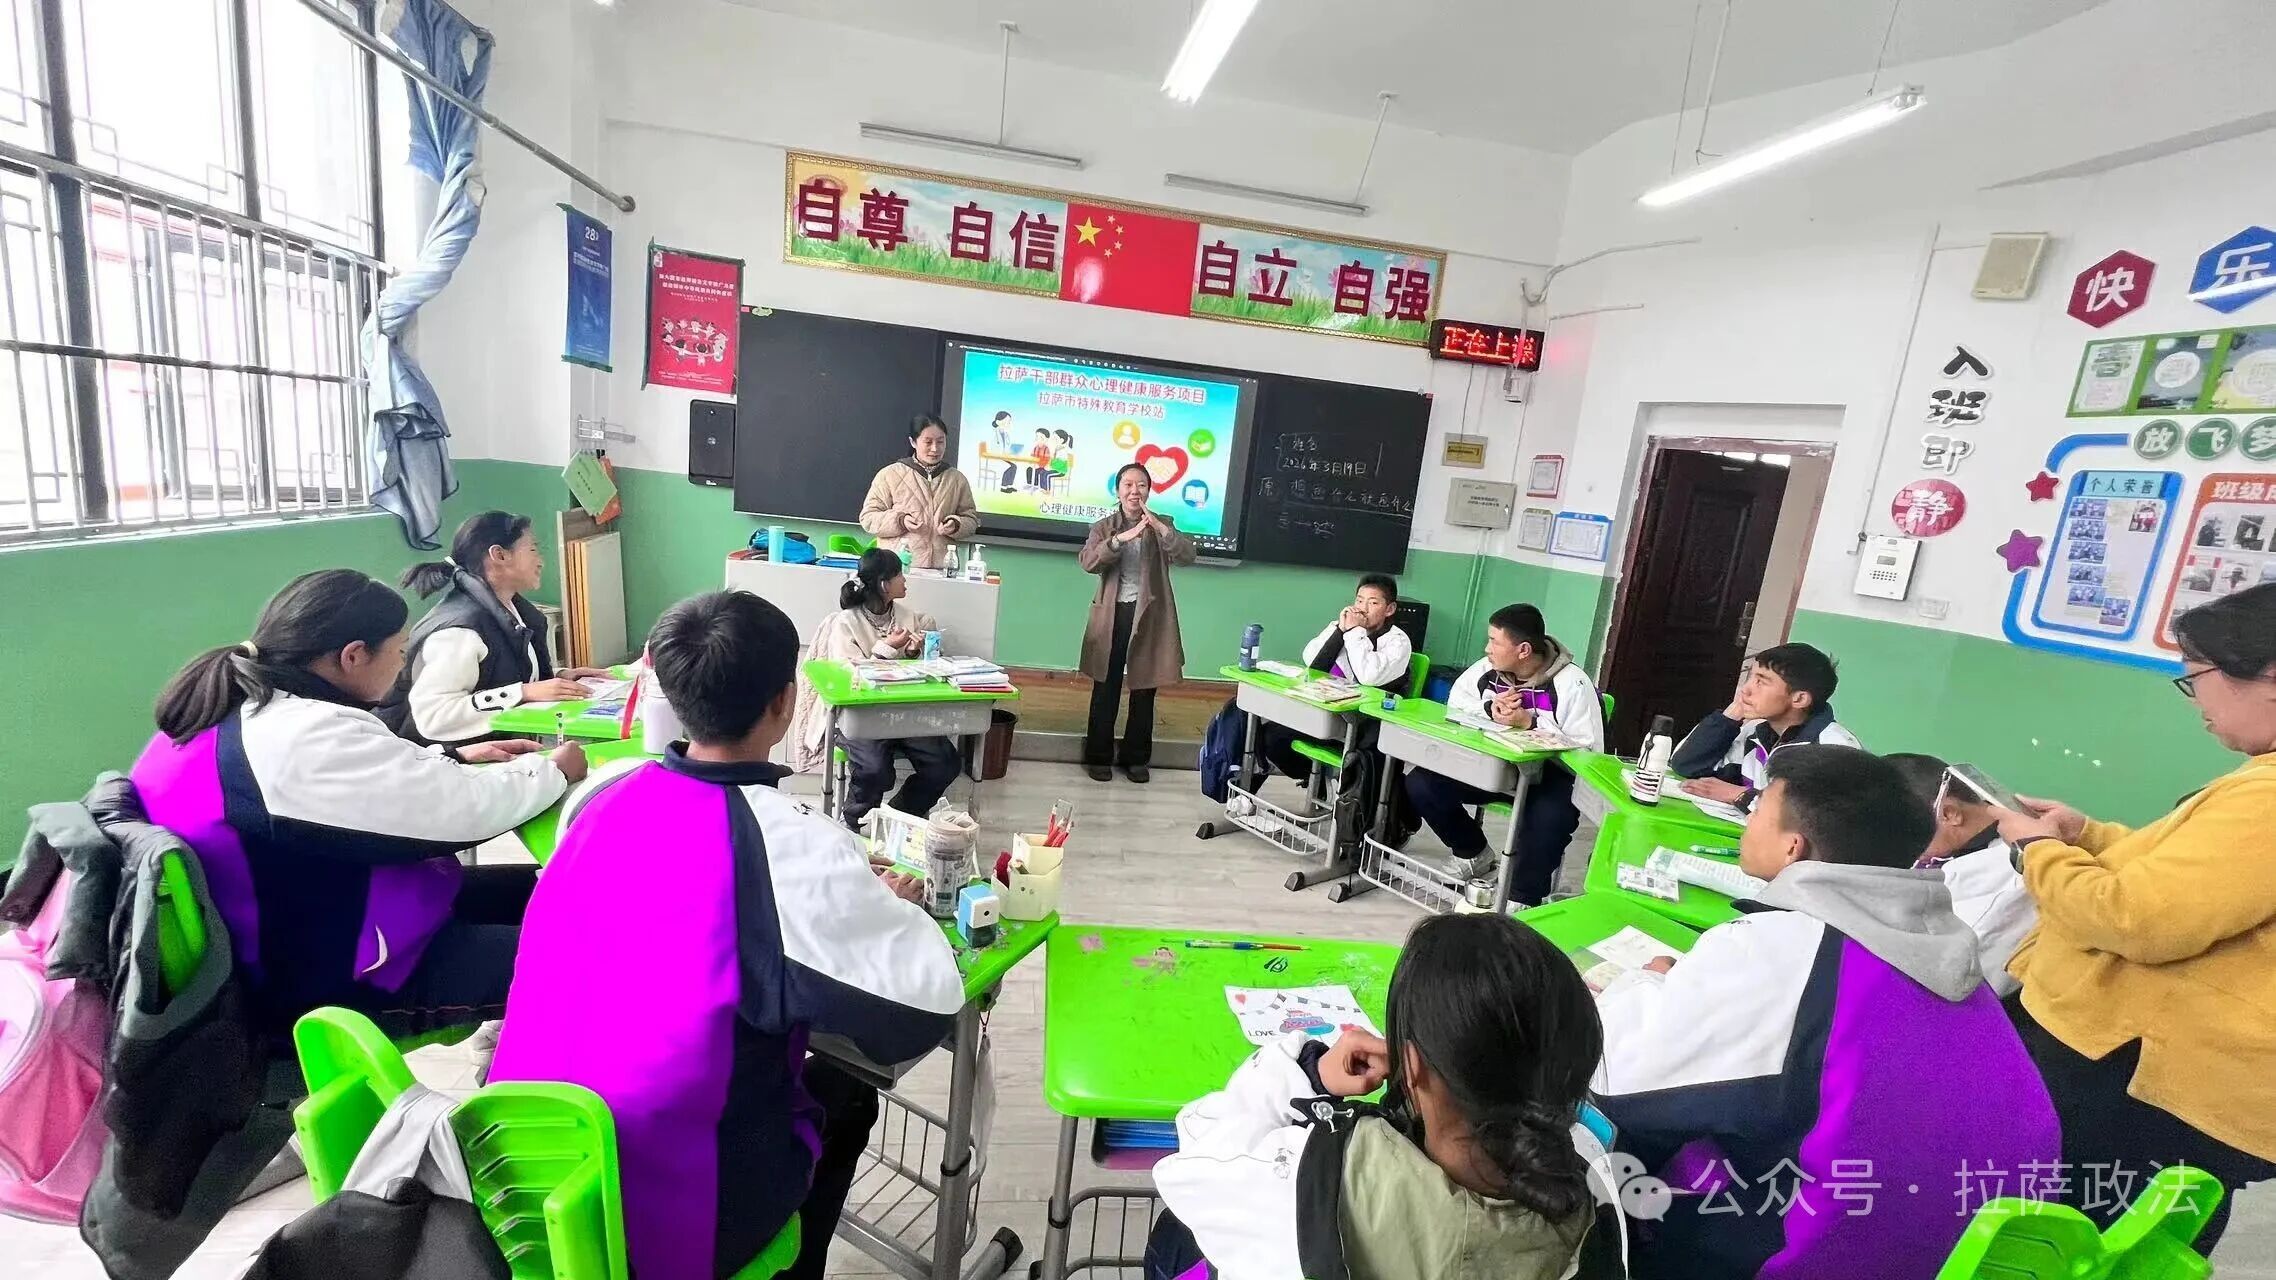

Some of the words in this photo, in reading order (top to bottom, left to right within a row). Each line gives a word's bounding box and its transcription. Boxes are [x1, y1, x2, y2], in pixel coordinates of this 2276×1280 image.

[799, 179, 909, 251] 自尊
[951, 201, 1059, 271] 自信
[1199, 239, 1297, 306] 自立
[1333, 259, 1430, 323] 自强
[999, 364, 1206, 403] 拉萨干部群众心理健康服务项目
[1039, 391, 1164, 418] 拉萨市特殊教育学校站
[1908, 345, 1988, 526] 入班即静
